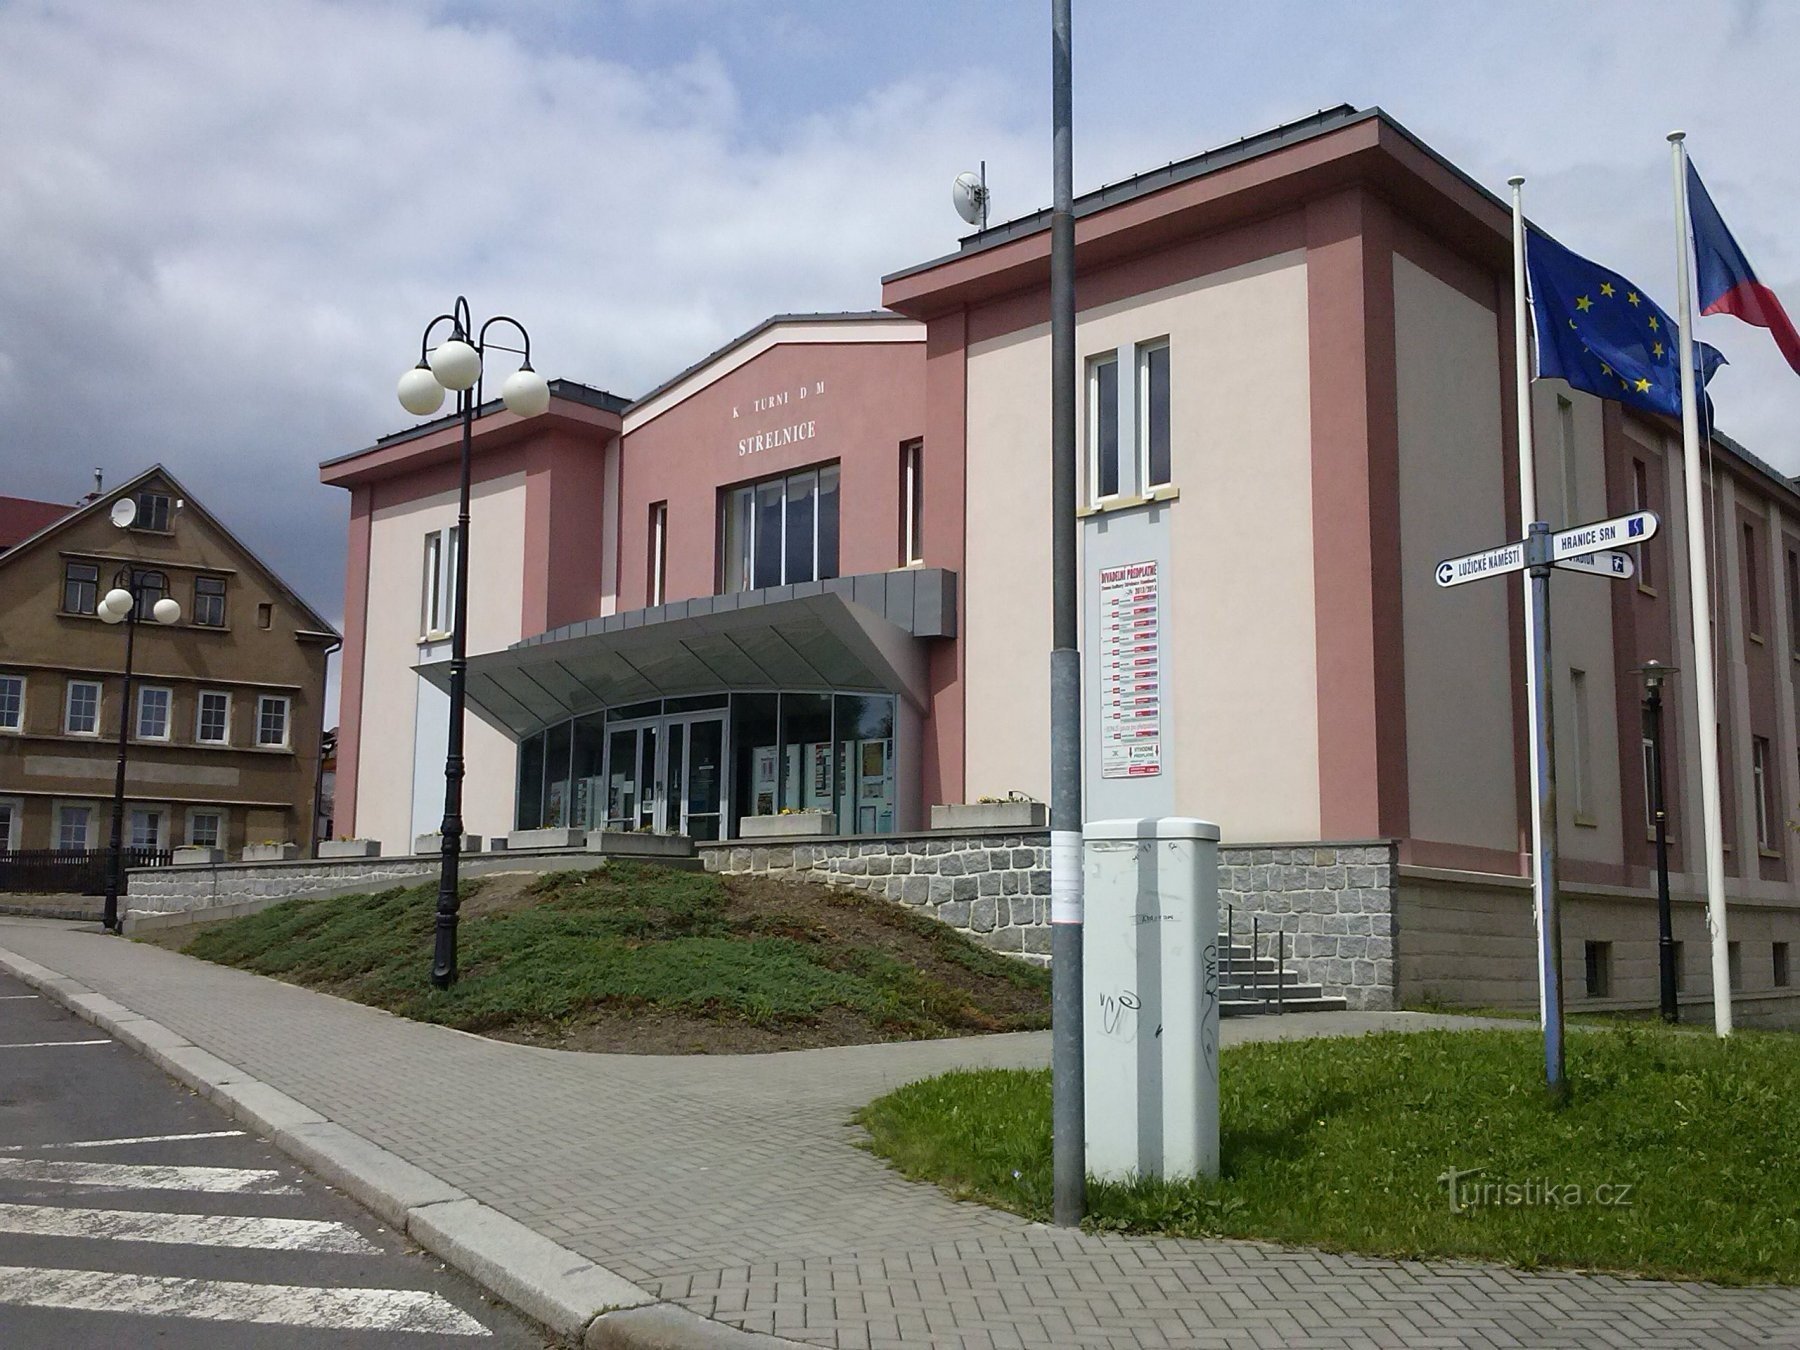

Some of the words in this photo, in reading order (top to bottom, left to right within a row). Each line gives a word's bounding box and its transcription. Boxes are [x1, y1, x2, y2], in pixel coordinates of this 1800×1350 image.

[738, 420, 816, 457] STŘELNICE
[1561, 530, 1596, 551] HRANICE
[1599, 525, 1616, 541] SRN
[1459, 554, 1487, 577] LUŽICKÉ
[1488, 545, 1520, 570] NÁMĚSTÍ
